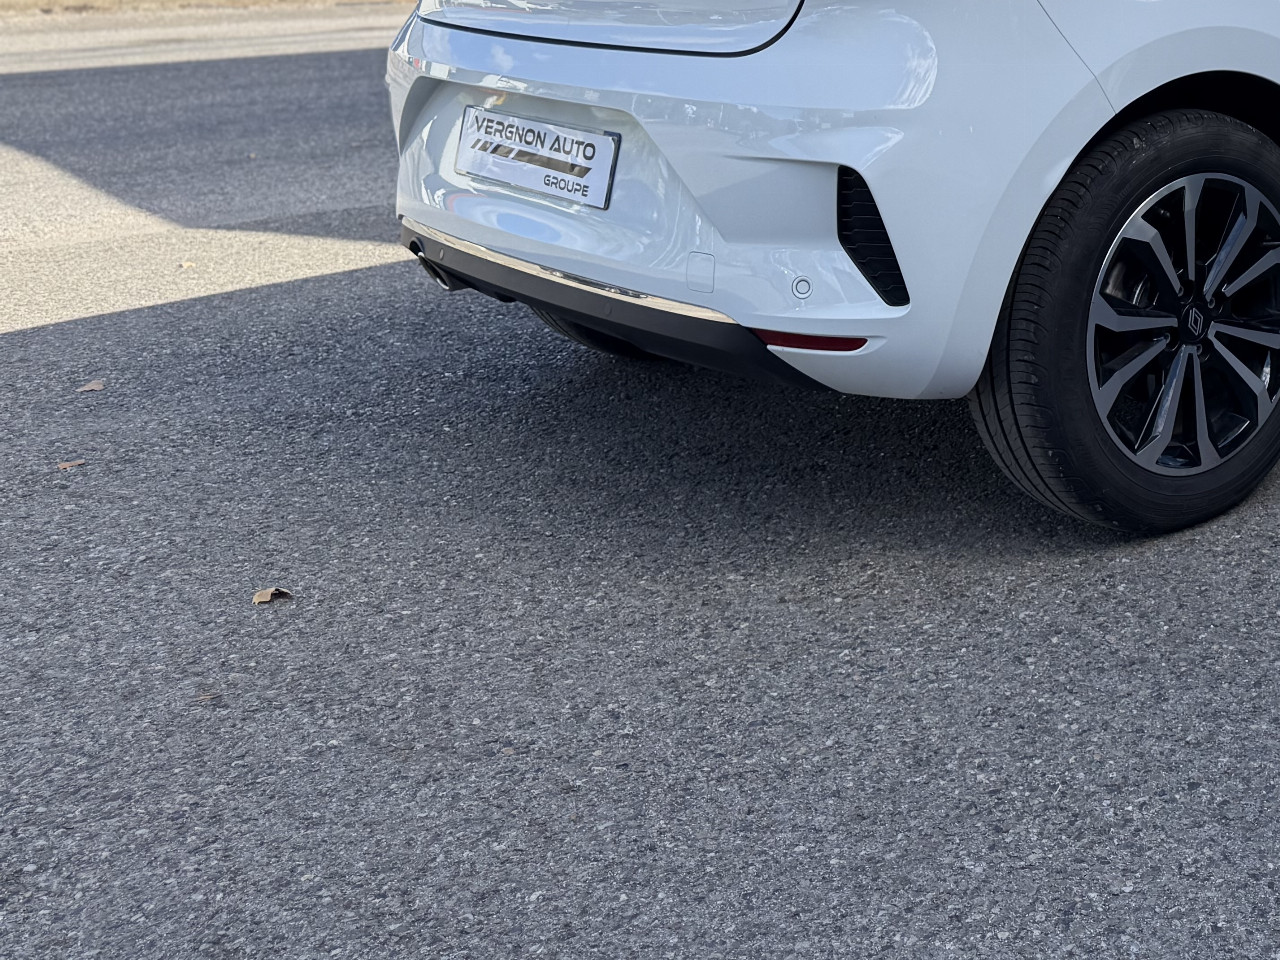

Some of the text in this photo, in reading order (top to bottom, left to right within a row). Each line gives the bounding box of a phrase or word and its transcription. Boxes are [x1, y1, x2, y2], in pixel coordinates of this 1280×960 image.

[474, 114, 596, 161] VERGNON AUTO
[543, 174, 590, 198] GROUPE
